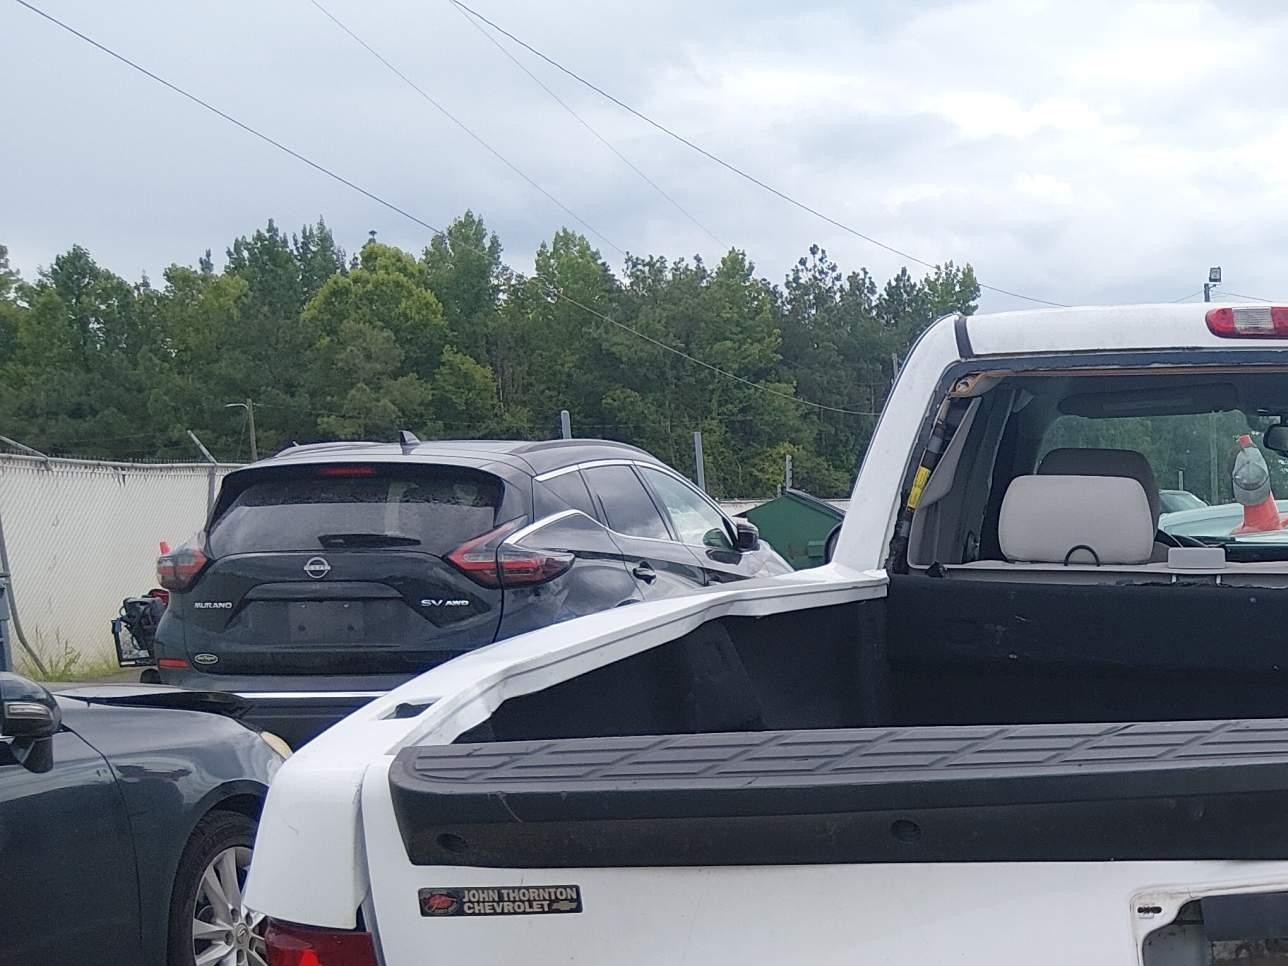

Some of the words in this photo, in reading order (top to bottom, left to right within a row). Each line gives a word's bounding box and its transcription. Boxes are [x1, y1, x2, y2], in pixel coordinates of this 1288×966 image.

[421, 599, 443, 607] SV
[463, 889, 498, 902] JOHN
[501, 887, 577, 901] THORNTON
[463, 900, 550, 914] CHEVROLET
